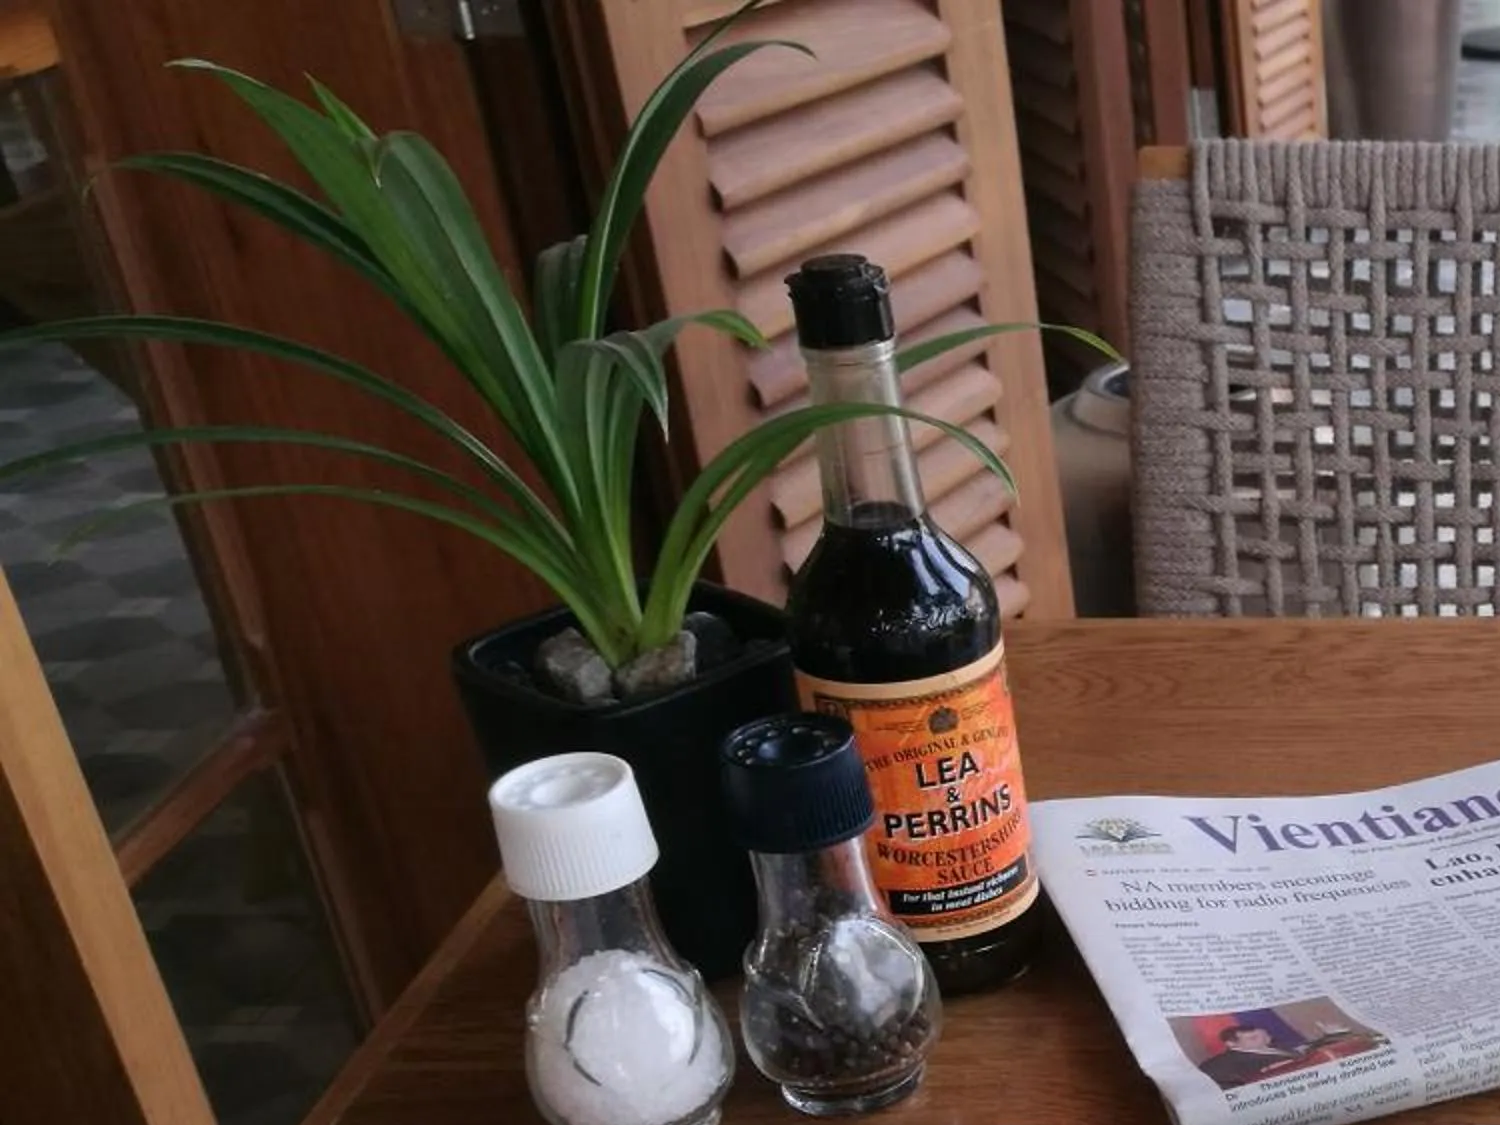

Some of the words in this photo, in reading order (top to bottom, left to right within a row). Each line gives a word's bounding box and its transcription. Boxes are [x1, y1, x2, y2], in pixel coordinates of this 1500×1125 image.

[865, 757, 893, 772] THE
[893, 738, 957, 763] ORIGINAL
[960, 734, 970, 747] &
[914, 751, 980, 789] LEA
[946, 787, 962, 804] &
[883, 784, 1012, 840] PERRINS
[937, 857, 995, 885] SAUCE
[1425, 851, 1494, 871] Lao,
[1120, 880, 1164, 894] NA
[1167, 878, 1266, 894] members
[1270, 868, 1376, 891] encourage
[922, 889, 945, 902] that
[1104, 899, 1193, 913] bidding
[1198, 897, 1228, 909] for
[1233, 893, 1289, 909] radio
[1293, 878, 1412, 903] frequencies
